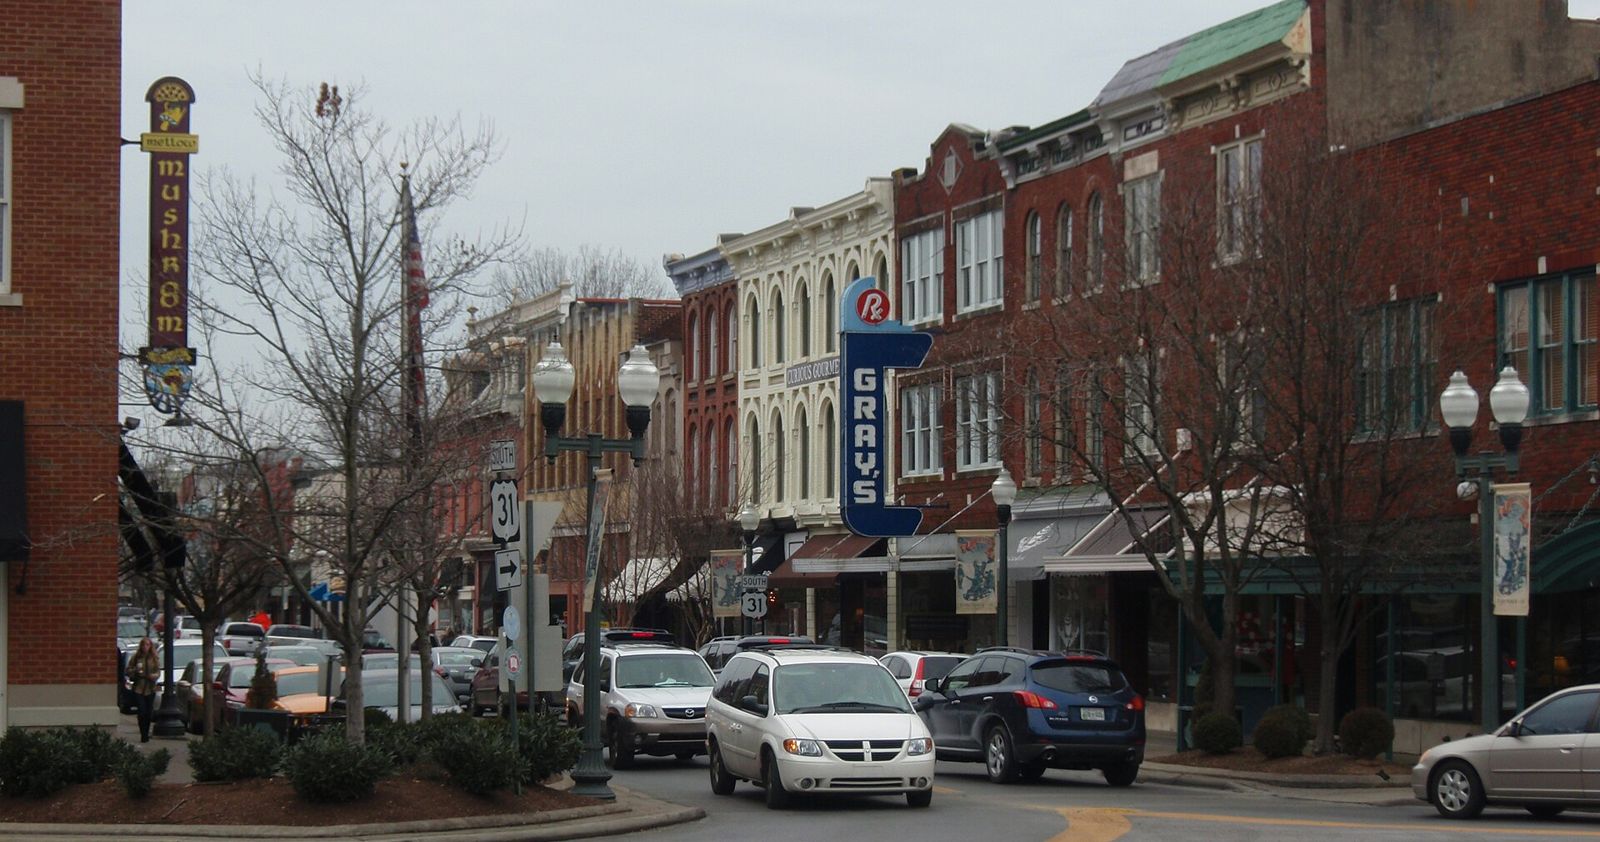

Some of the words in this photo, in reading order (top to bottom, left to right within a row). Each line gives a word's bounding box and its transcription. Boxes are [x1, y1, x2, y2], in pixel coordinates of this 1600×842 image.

[146, 137, 196, 149] mellow
[787, 365, 812, 384] CURIOUS
[813, 359, 840, 378] GOURME
[853, 367, 881, 505] GRAY'S
[492, 447, 515, 464] SOUTH
[498, 493, 515, 527] 31
[743, 578, 767, 586] SOUTH
[748, 598, 763, 612] 31
